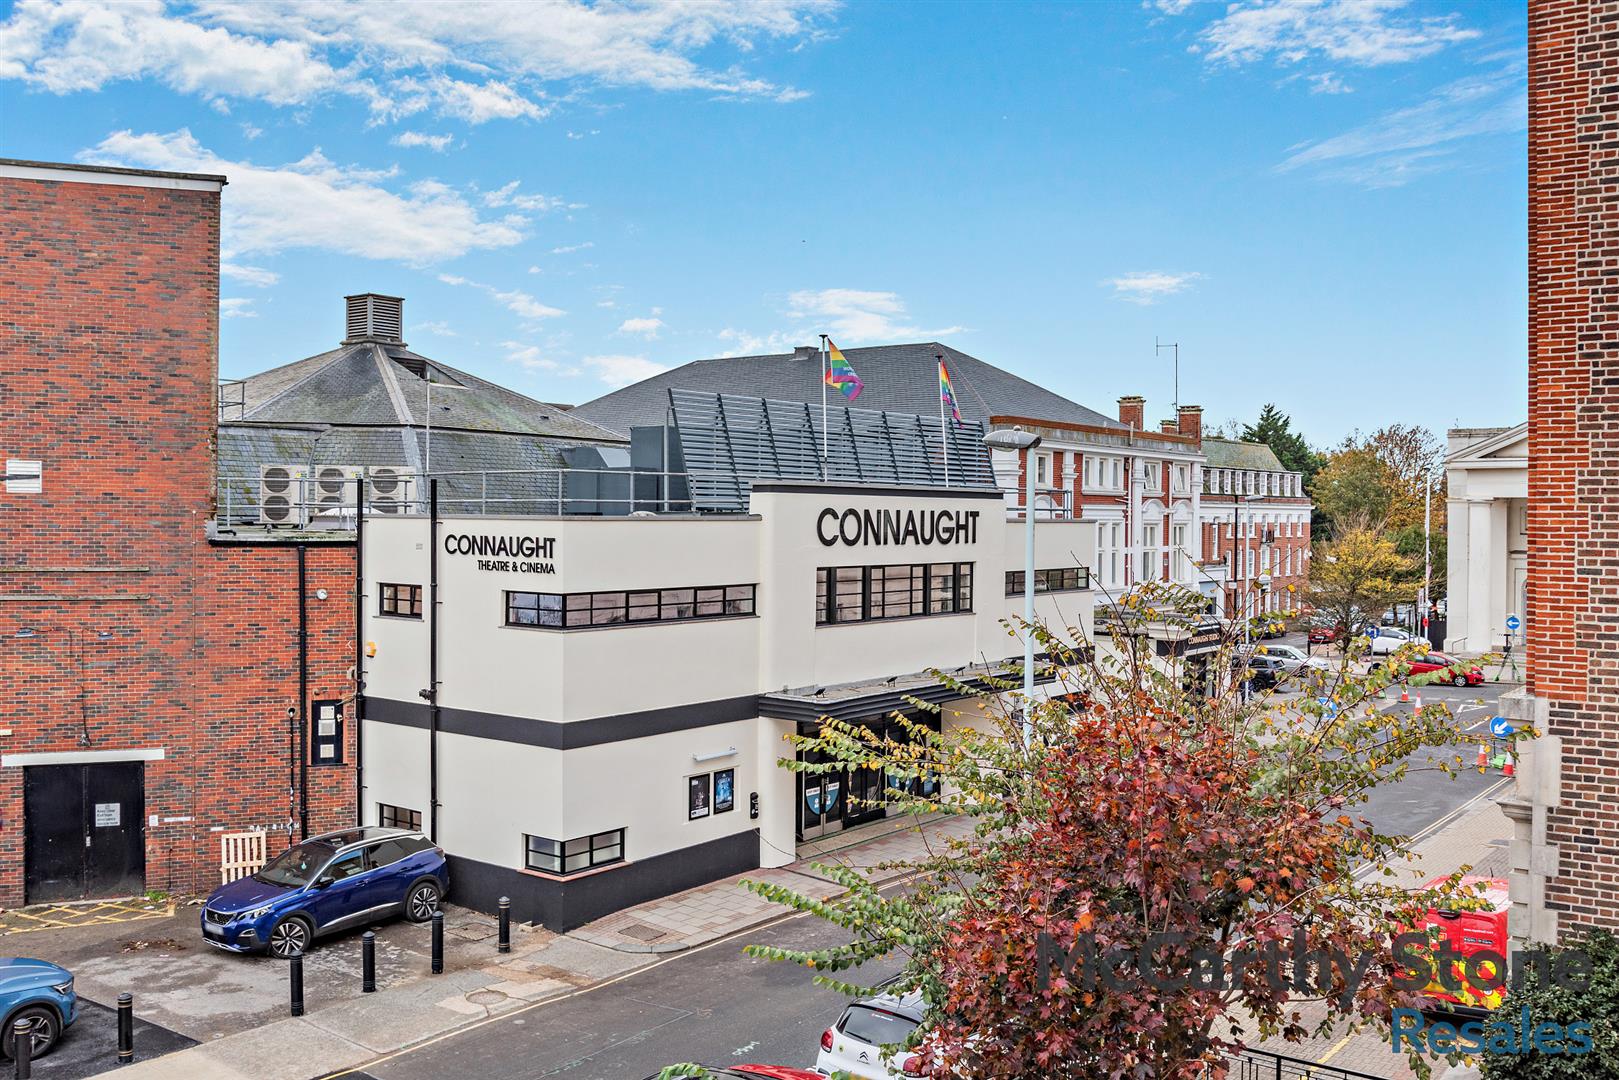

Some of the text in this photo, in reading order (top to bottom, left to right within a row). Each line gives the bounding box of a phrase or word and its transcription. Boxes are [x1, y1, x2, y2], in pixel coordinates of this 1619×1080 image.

[816, 507, 980, 547] CONNAUGHT
[444, 534, 556, 558] CONNAUGHT
[478, 560, 555, 574] THEATRE & CINEMA
